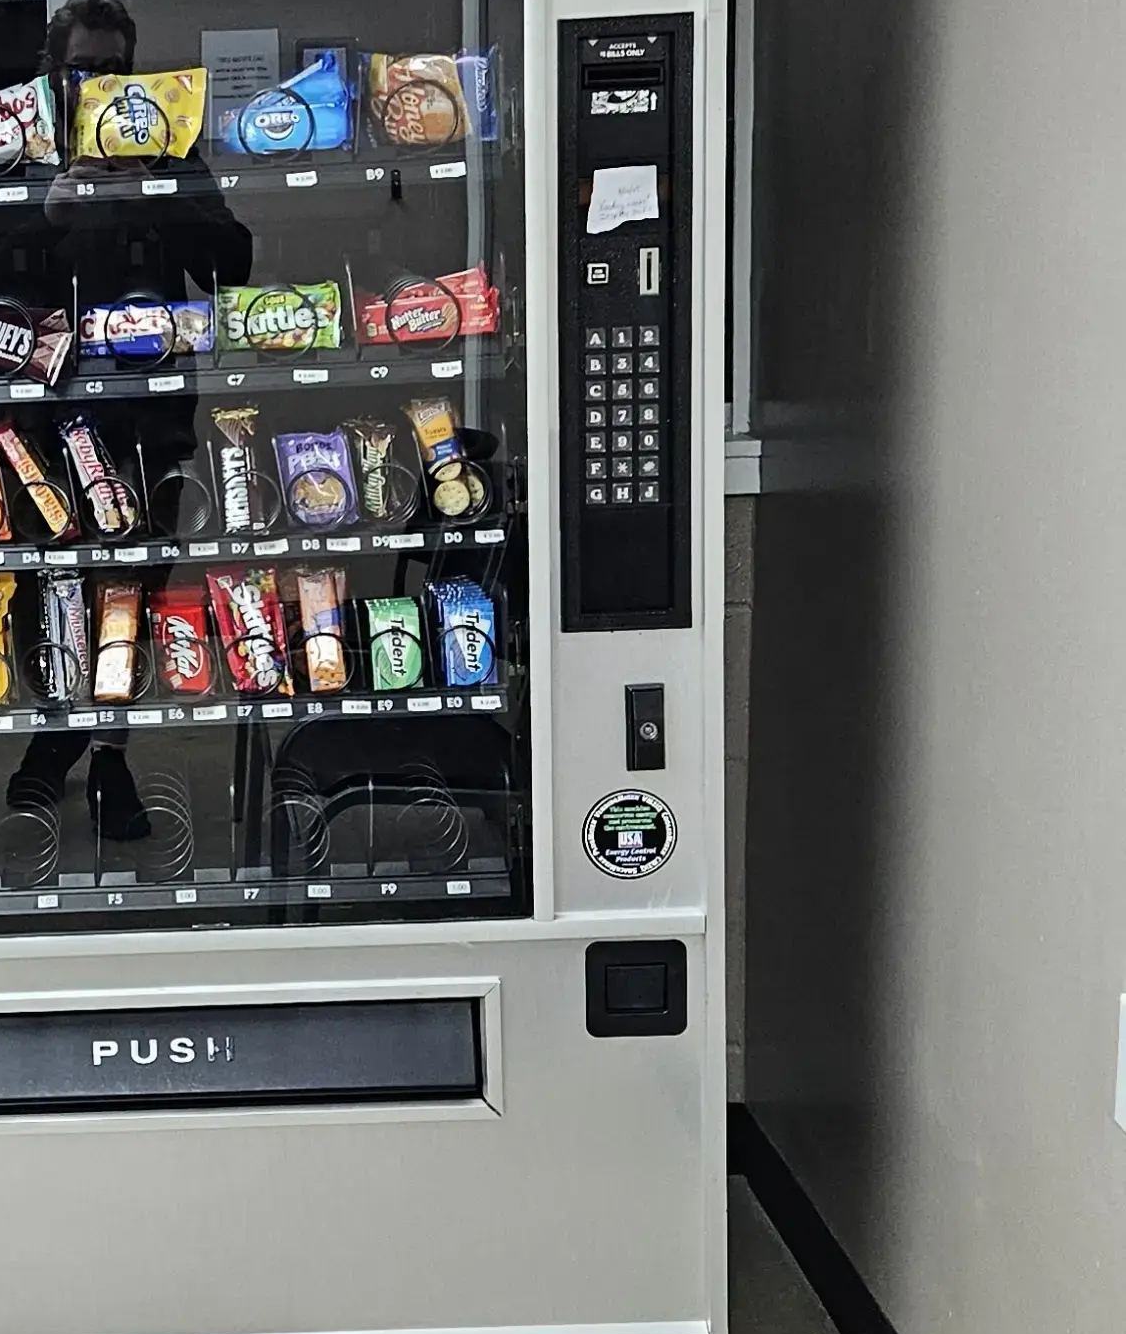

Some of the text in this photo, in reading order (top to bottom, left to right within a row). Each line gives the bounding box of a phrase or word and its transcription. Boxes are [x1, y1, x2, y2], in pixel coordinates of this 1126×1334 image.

[254, 112, 300, 129] OREO
[366, 168, 384, 180] B9
[220, 175, 240, 189] B7
[77, 183, 95, 195] B5
[390, 307, 424, 330] Nutter
[408, 310, 441, 332] Butter
[590, 330, 654, 345] A 1 2
[590, 356, 654, 371] B 3 4
[370, 366, 389, 379] C9
[227, 373, 245, 386] C7
[85, 381, 104, 393] C5
[589, 382, 654, 397] C 5 6
[589, 408, 654, 424] D 7 8
[590, 434, 654, 449] E 9 0
[590, 463, 602, 475] F
[590, 486, 653, 501] G H J
[162, 545, 180, 557] D6
[231, 542, 250, 554] D7
[302, 538, 320, 551] D8
[22, 551, 41, 563] D4
[91, 549, 110, 561] D5
[390, 617, 407, 677] Trdent
[464, 611, 483, 672] Trdent
[237, 704, 252, 716] E7
[307, 701, 323, 714] E8
[377, 699, 394, 711] E9
[30, 713, 46, 726] E4
[100, 711, 115, 723] E5
[168, 708, 184, 720] E6
[621, 832, 642, 846] USA
[243, 888, 260, 900] F7
[381, 883, 397, 895] F9
[108, 893, 123, 905] F5
[91, 1034, 235, 1067] PUSH
